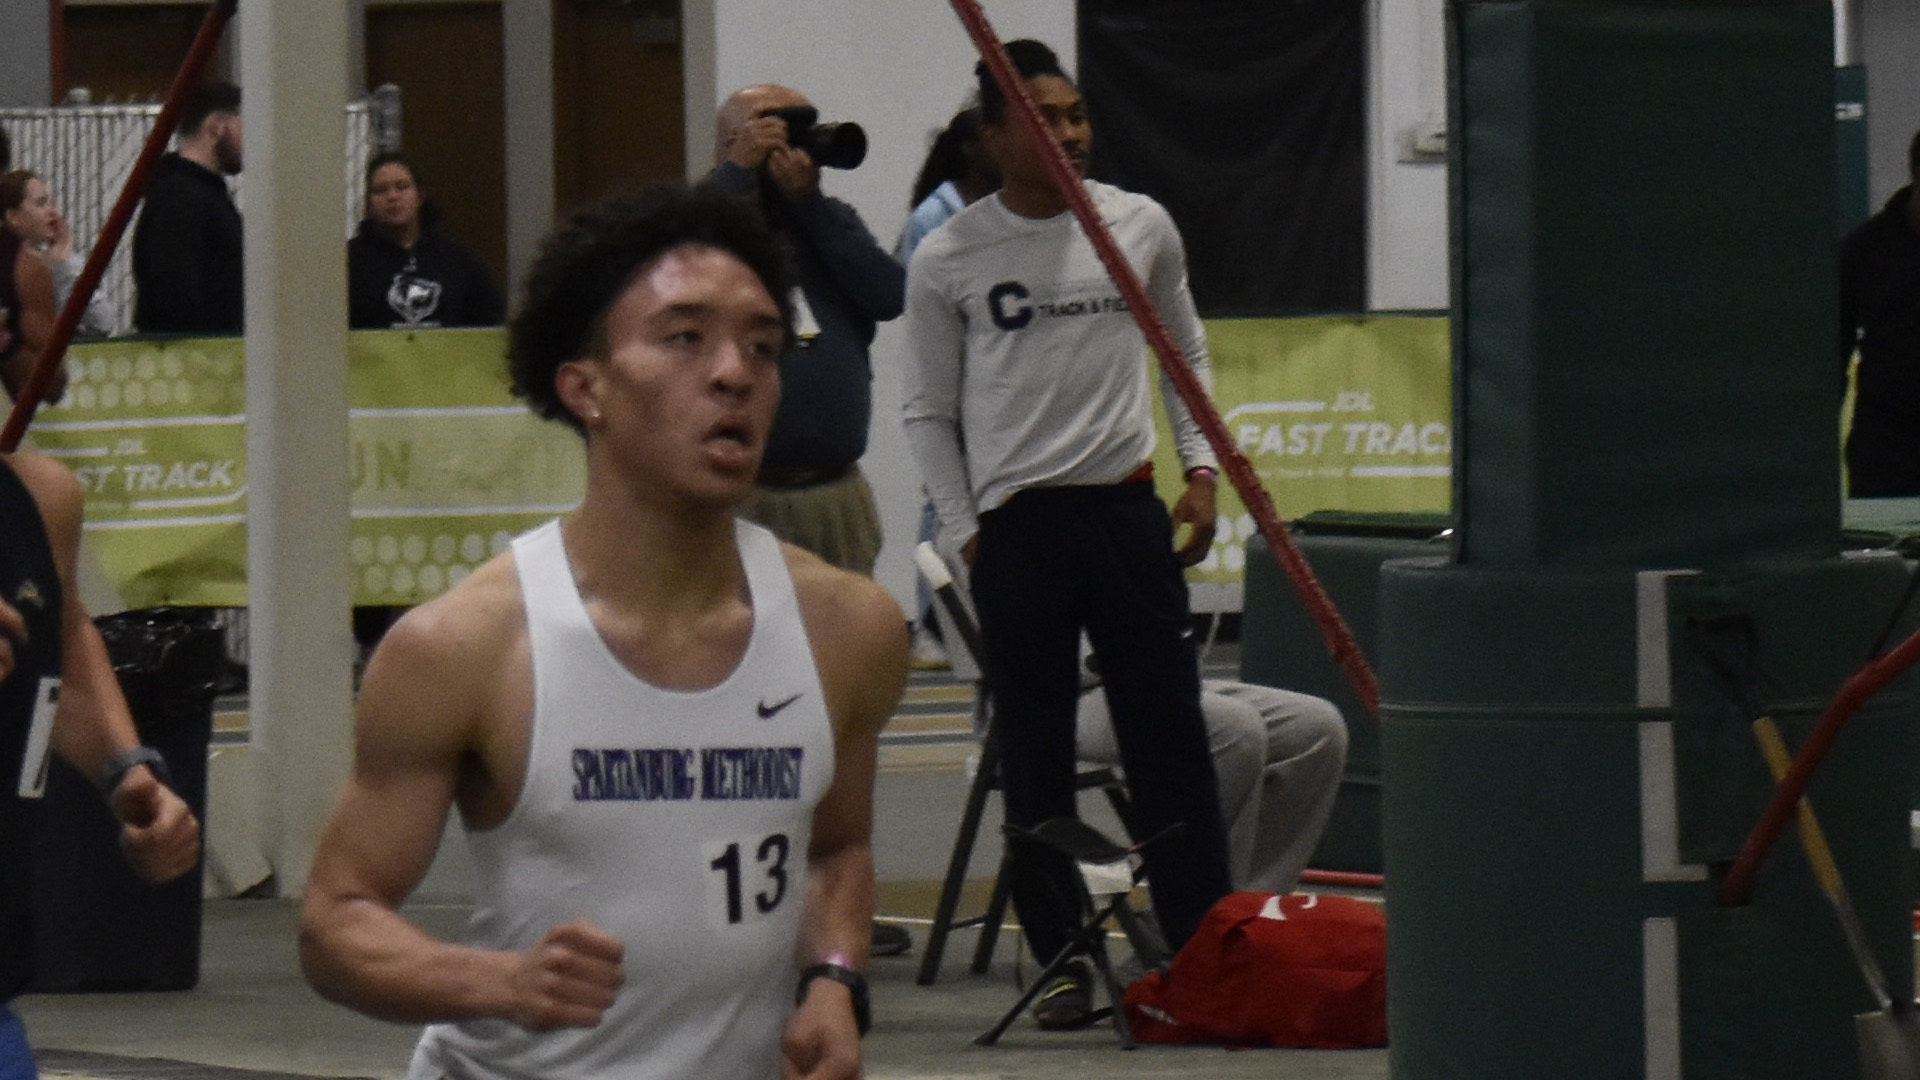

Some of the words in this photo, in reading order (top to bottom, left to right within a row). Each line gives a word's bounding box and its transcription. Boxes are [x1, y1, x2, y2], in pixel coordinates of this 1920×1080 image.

[989, 282, 1033, 330] C
[1237, 423, 1331, 455] FAST
[1344, 422, 1450, 455] TRAC
[124, 461, 234, 491] TRACK
[573, 749, 695, 801] SPARTANBURG
[700, 748, 803, 800] METHODIST
[711, 834, 789, 925] 13
